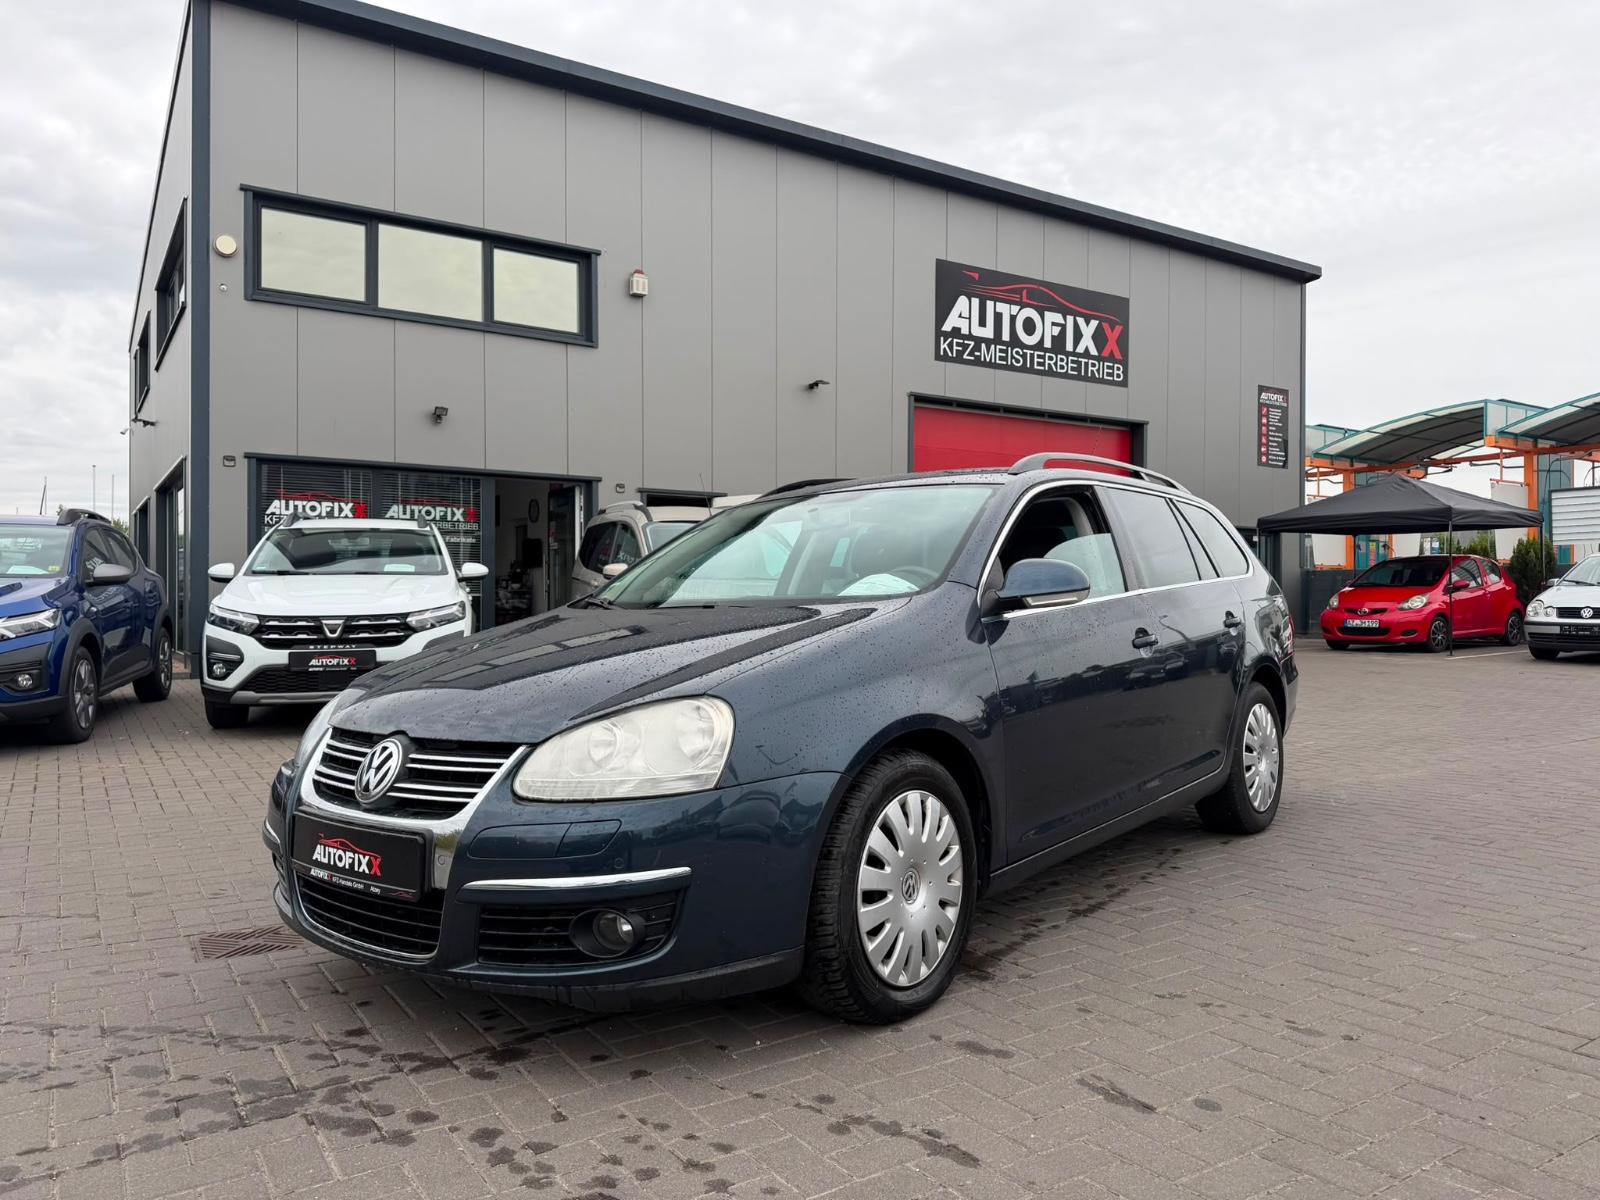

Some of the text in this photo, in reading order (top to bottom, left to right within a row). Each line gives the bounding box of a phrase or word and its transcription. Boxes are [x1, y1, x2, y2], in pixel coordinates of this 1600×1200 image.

[941, 295, 1124, 361] AUTOFIXX
[940, 336, 1124, 382] KFZ-MEISTERBETRIEB
[312, 843, 382, 877] AUTOFIXX
